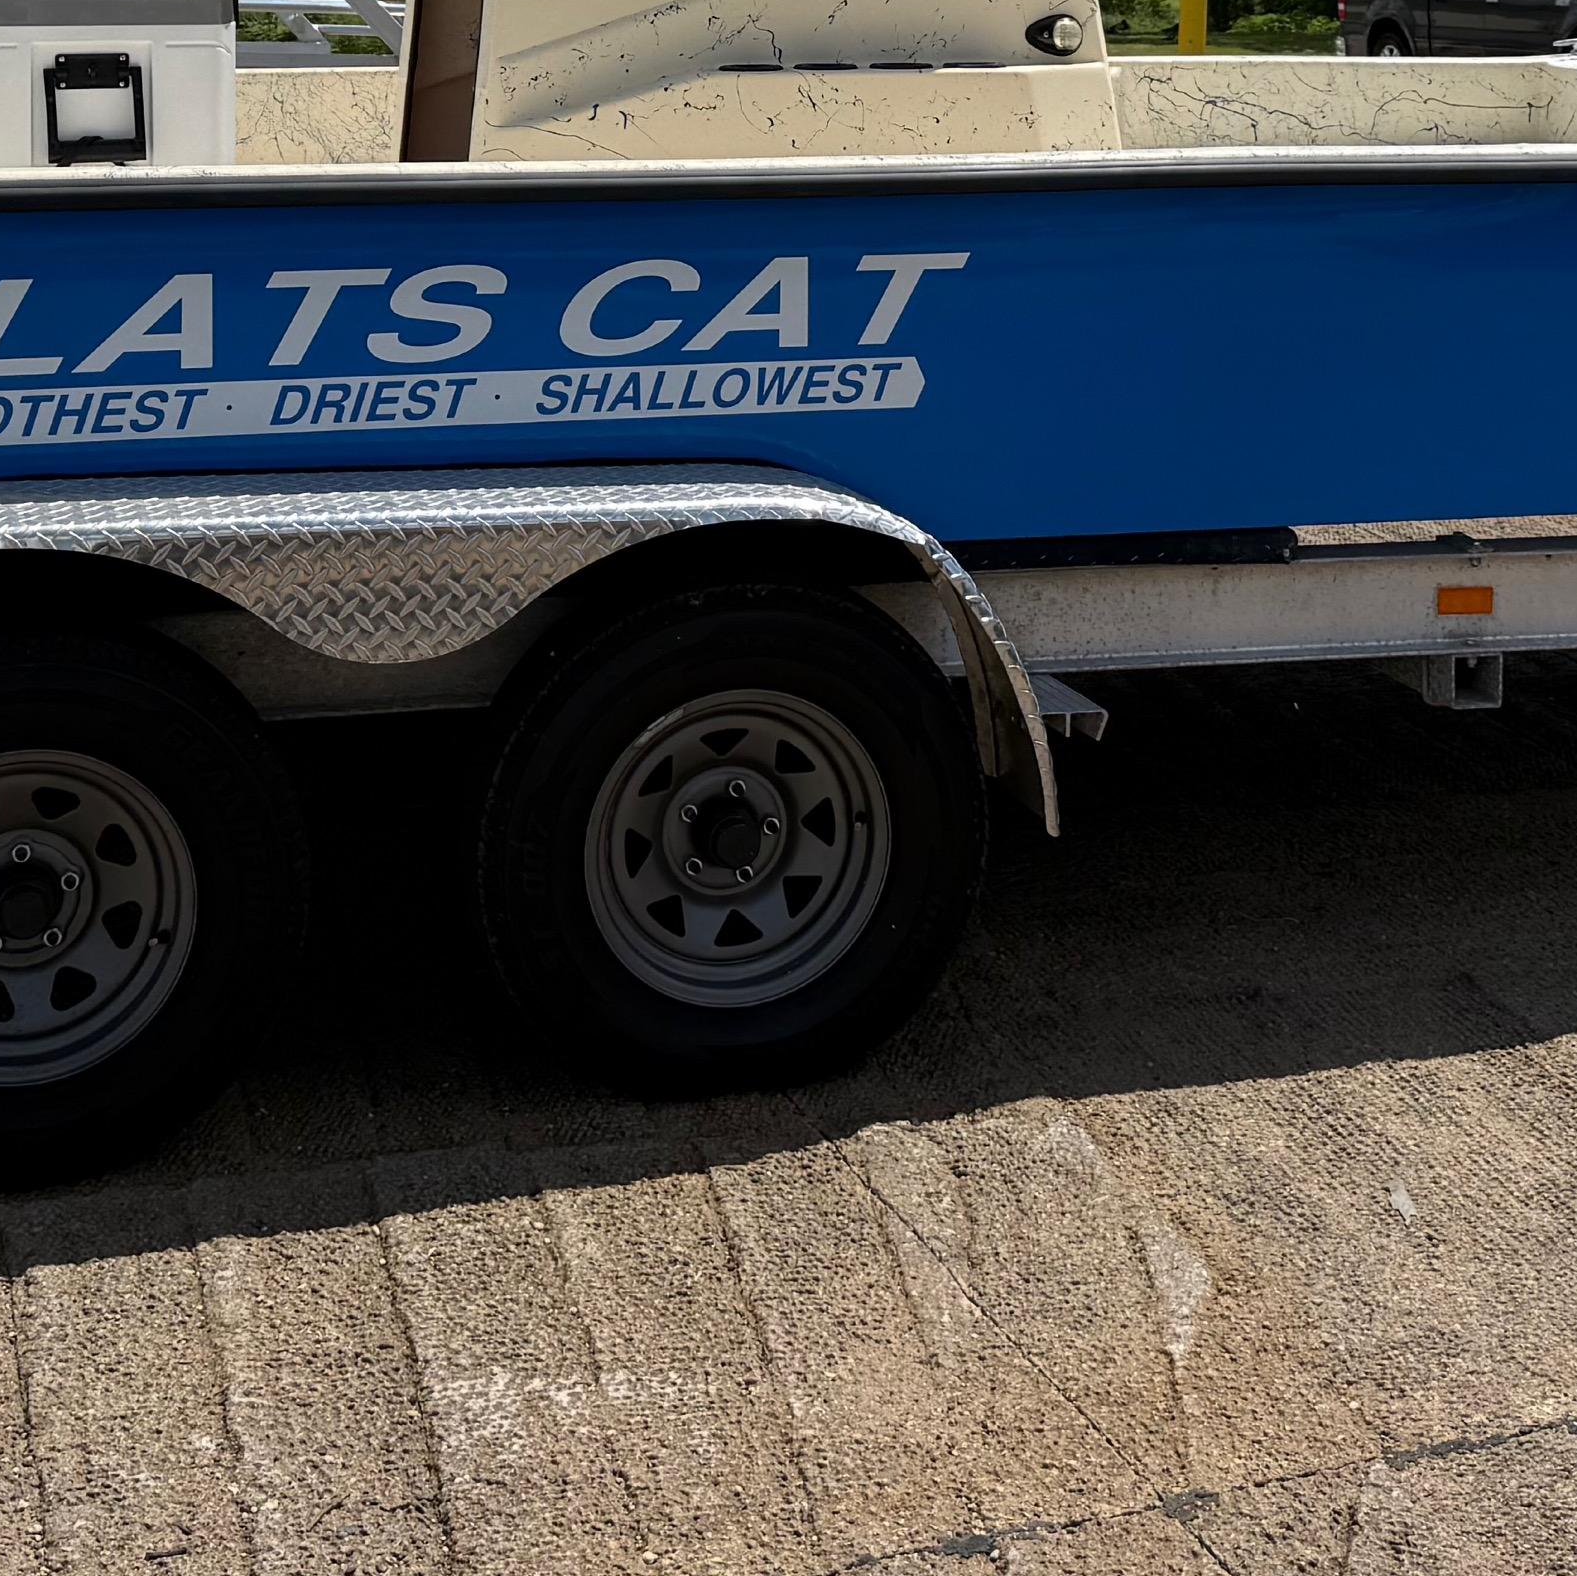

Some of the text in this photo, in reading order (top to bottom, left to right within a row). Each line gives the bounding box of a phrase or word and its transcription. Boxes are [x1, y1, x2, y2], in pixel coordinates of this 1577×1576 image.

[559, 251, 971, 357] CAT
[269, 377, 477, 426] DRIEST
[535, 362, 902, 416] SHALLOWEST
